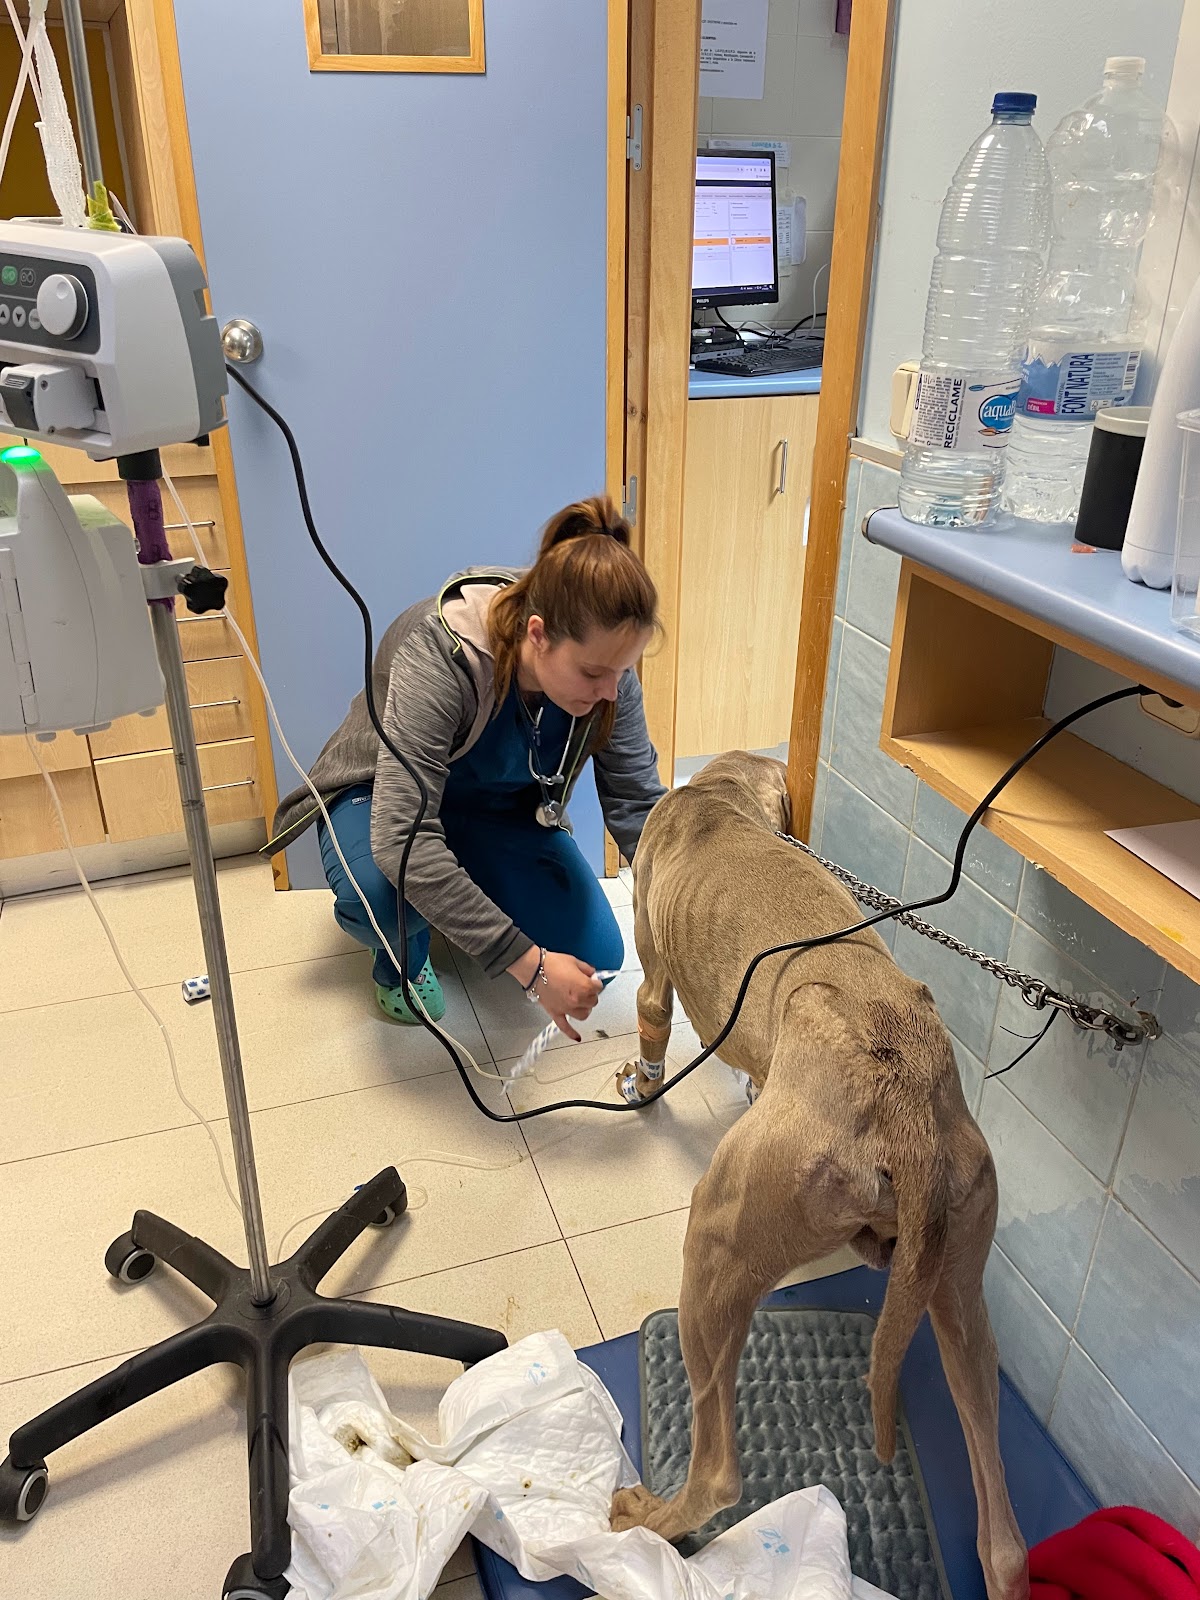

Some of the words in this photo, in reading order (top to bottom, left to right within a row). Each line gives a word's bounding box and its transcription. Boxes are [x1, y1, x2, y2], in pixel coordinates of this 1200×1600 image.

[1065, 353, 1095, 389] NATURA
[943, 379, 963, 448] RECÍCLAME
[1061, 391, 1087, 413] FONT
